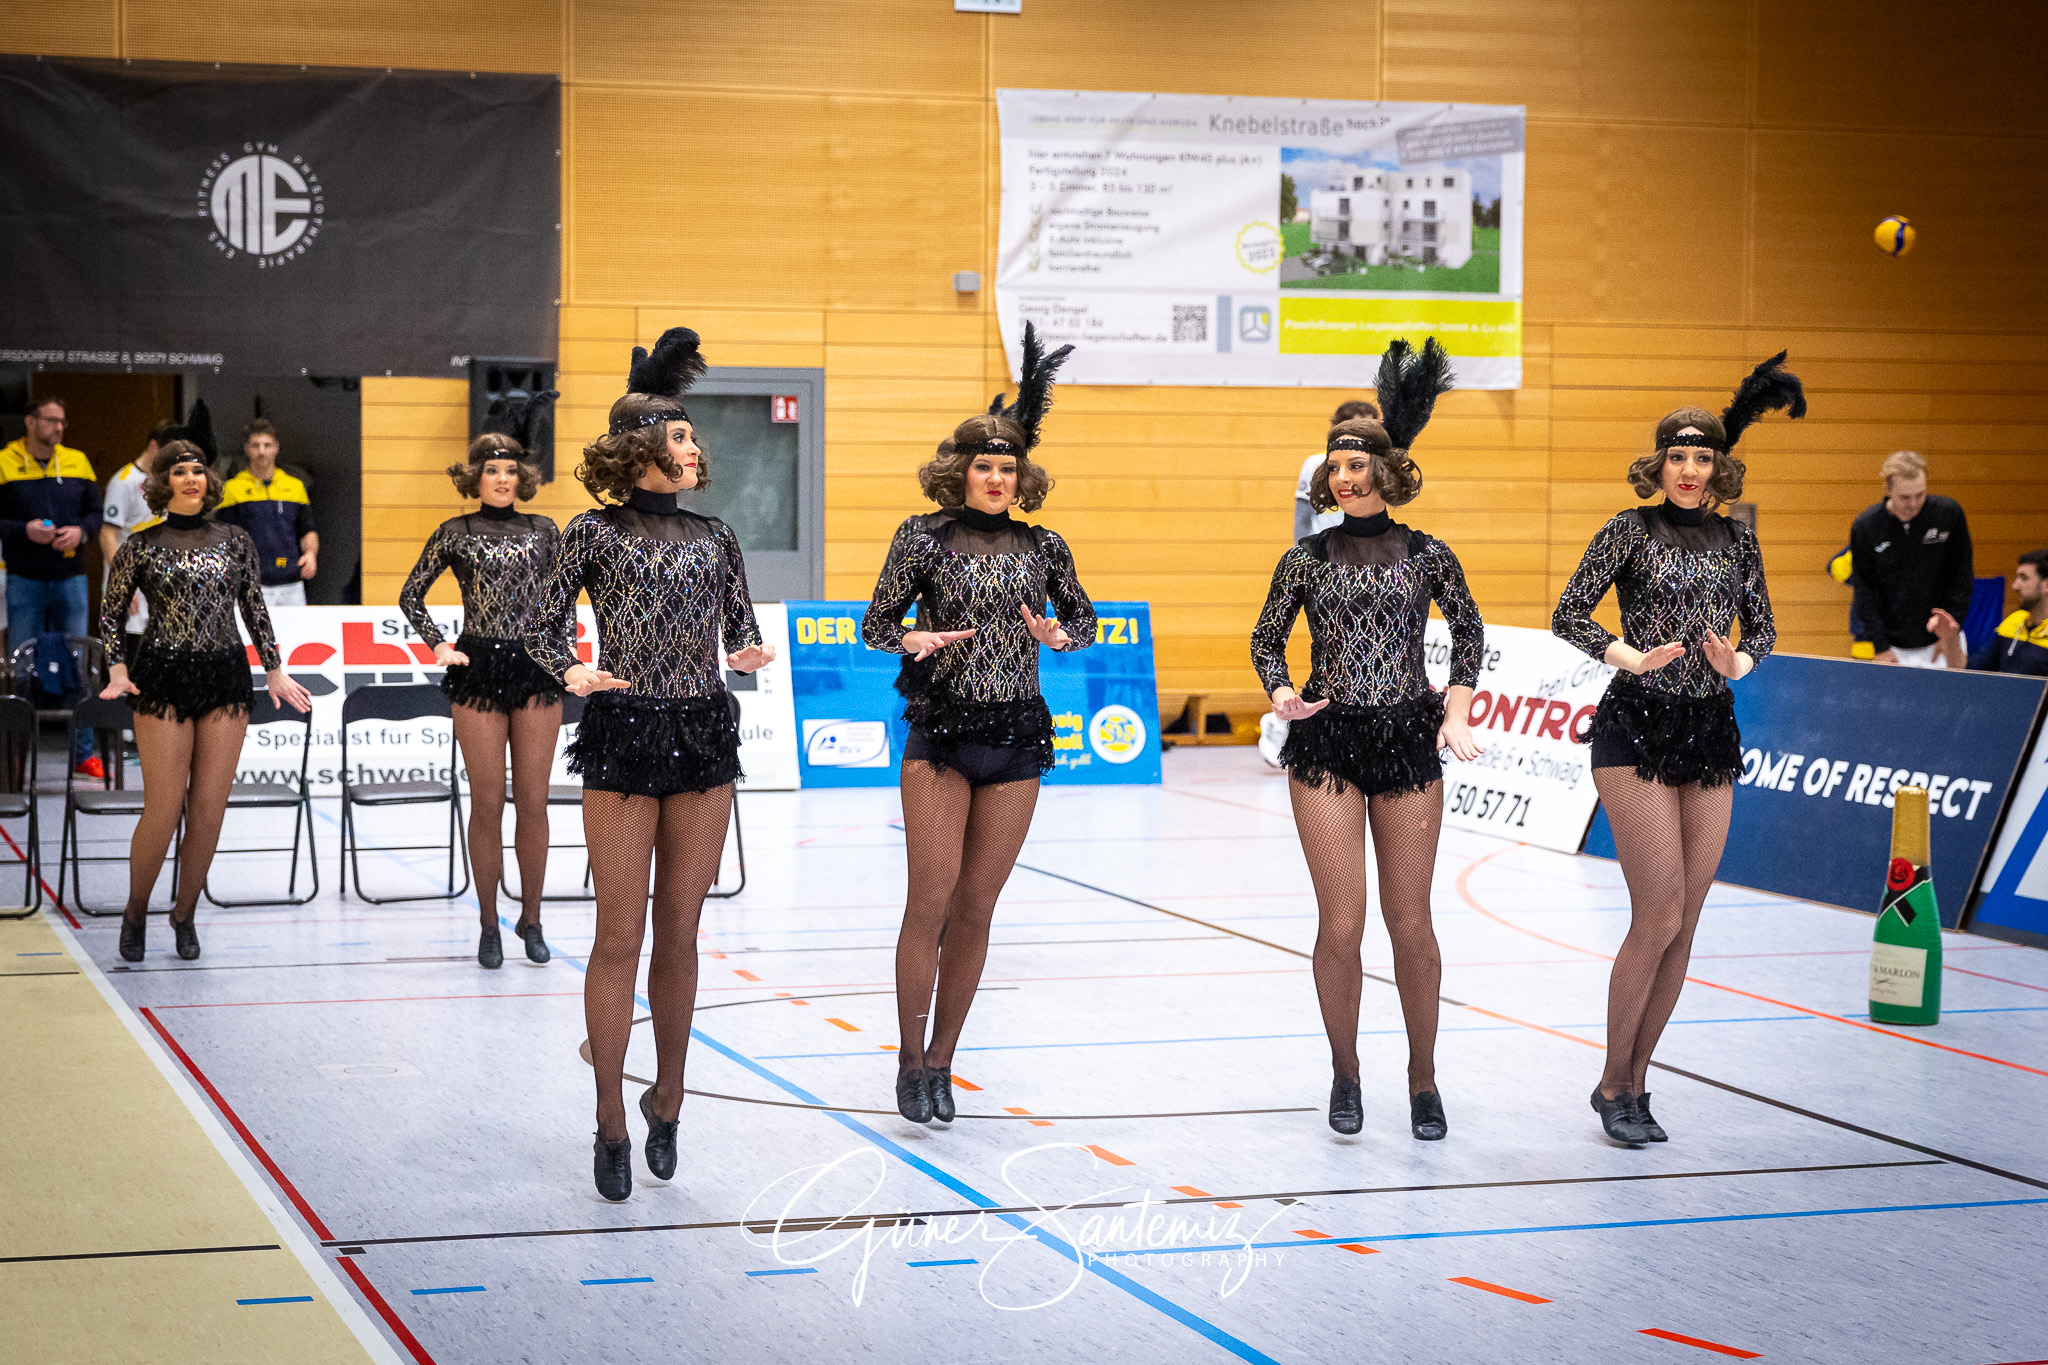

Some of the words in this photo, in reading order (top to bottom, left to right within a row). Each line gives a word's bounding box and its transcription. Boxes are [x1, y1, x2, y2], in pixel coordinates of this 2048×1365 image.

[1208, 113, 1344, 137] Knebelstraße
[243, 141, 279, 154] GYM
[197, 152, 230, 217] FITNESS
[210, 154, 311, 256] ME
[257, 154, 325, 269] PHYSIOTHERAPIE
[206, 231, 236, 259] EMS
[66, 351, 120, 364] STRASSE
[167, 353, 224, 366] SCHWAIG
[450, 355, 471, 367] INF
[796, 617, 858, 645] DER
[1095, 617, 1139, 645] TZ!
[381, 728, 412, 745] für
[741, 723, 775, 742] ule
[1525, 749, 1584, 791] Schwaig
[1737, 746, 1806, 793] OME
[1802, 757, 1850, 798] OF
[1477, 788, 1506, 820] 57
[1505, 794, 1532, 827] 71
